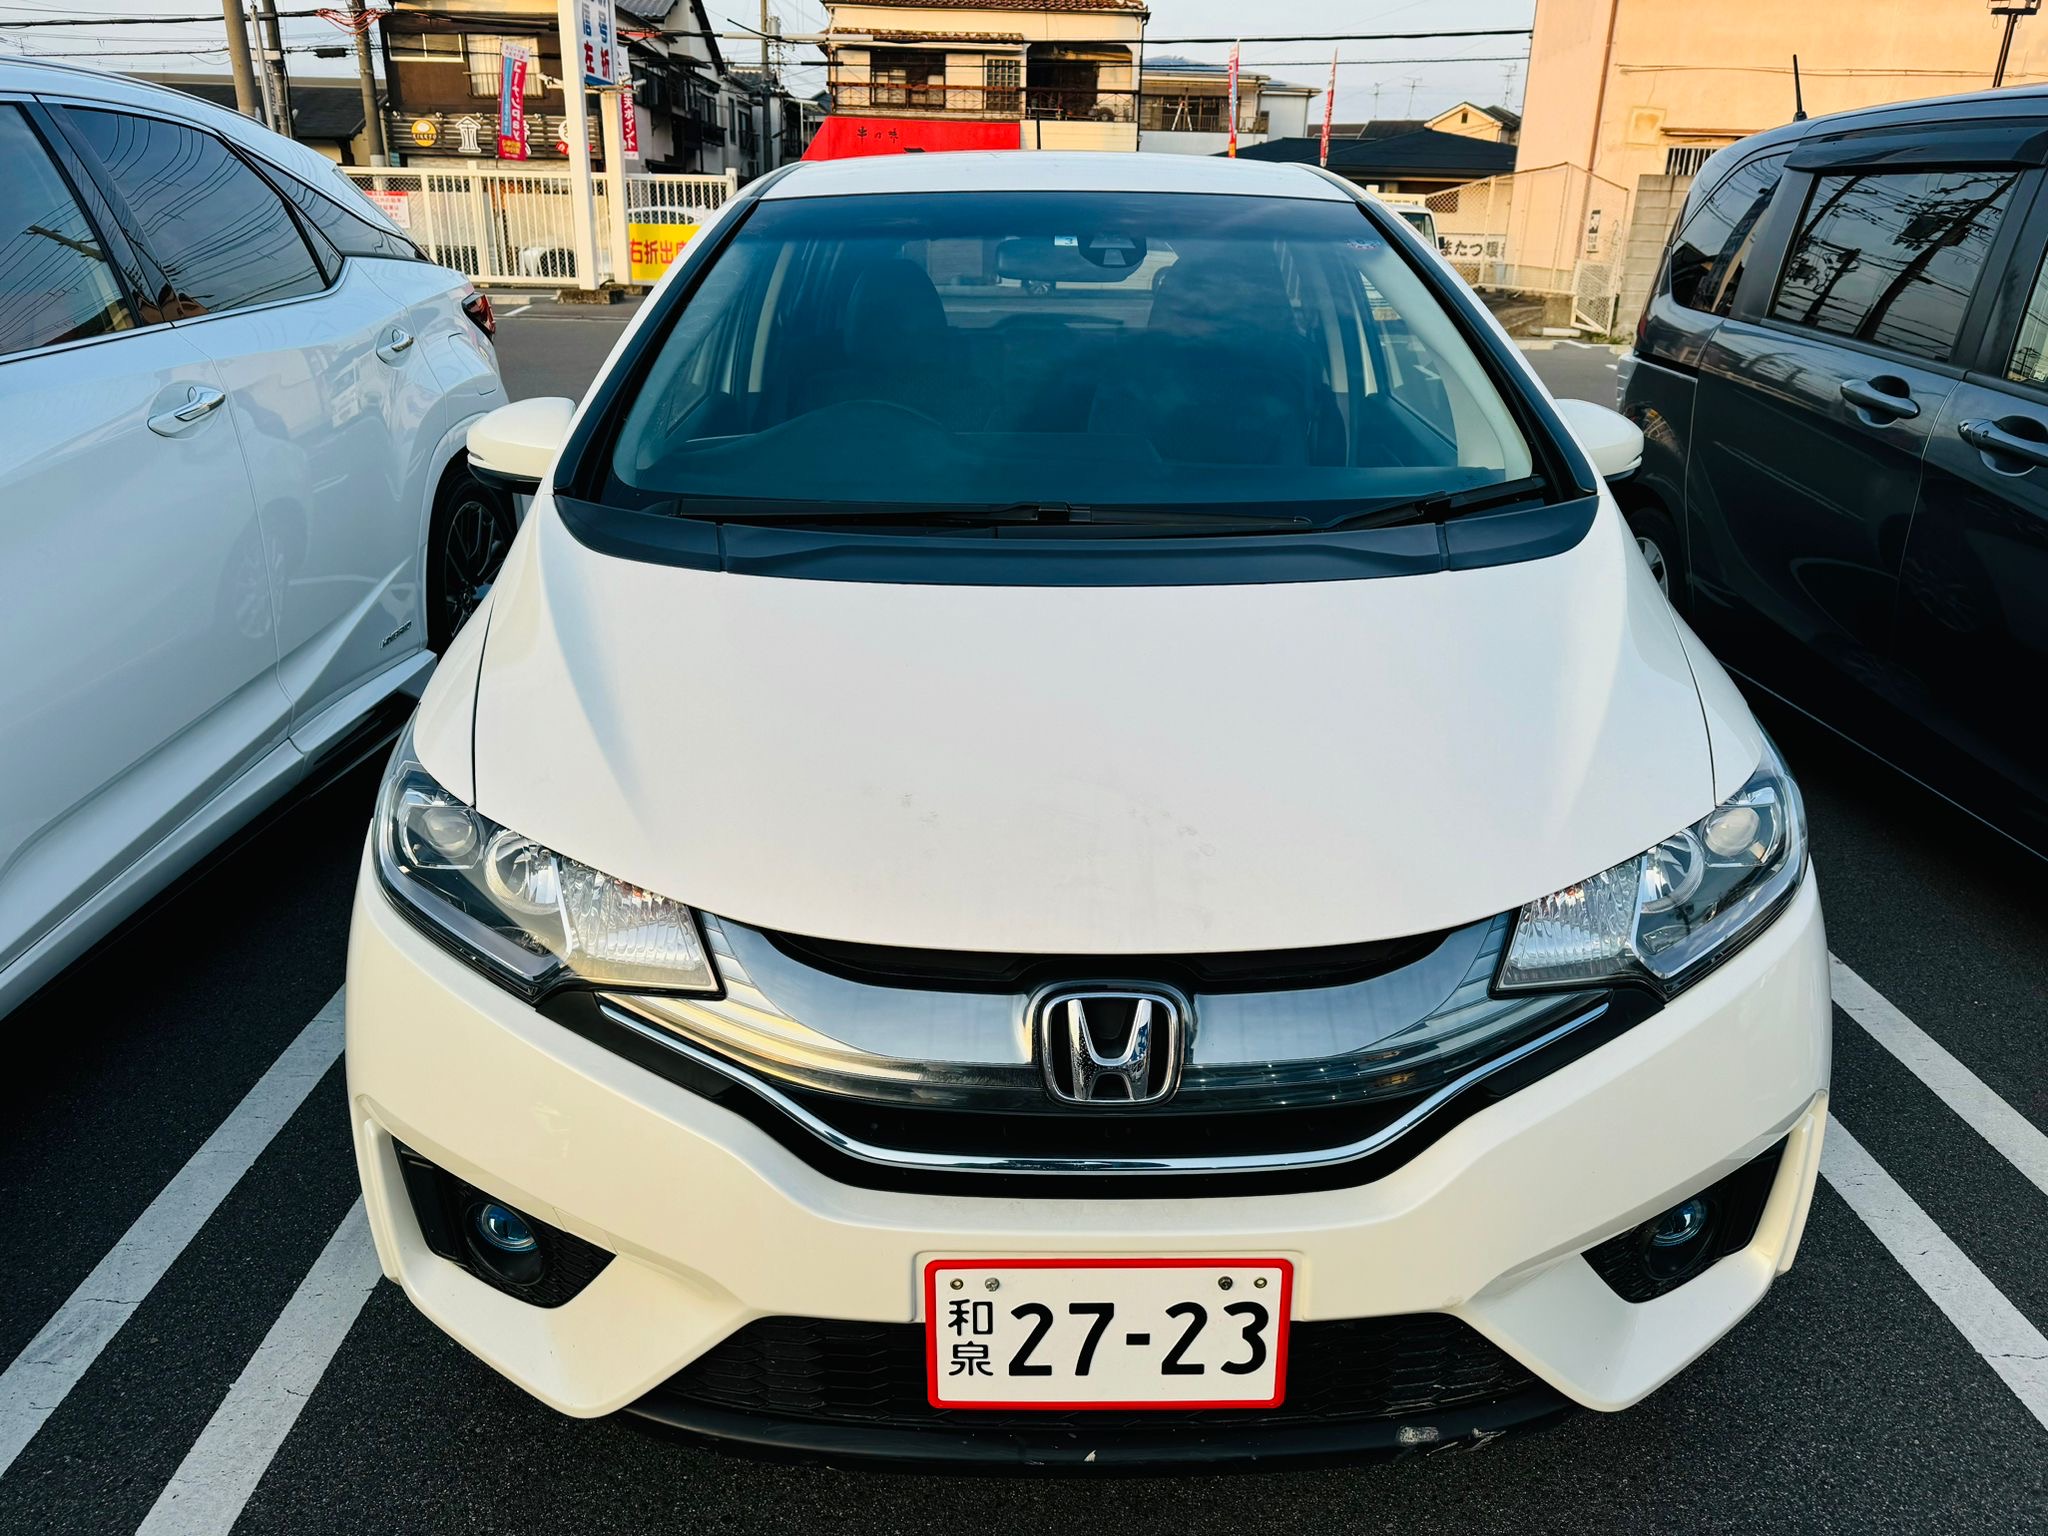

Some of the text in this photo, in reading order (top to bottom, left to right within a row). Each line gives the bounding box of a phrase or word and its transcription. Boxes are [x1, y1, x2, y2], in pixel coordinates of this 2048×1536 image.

[584, 40, 611, 80] 左折
[948, 1299, 994, 1377] 和泉
[1008, 1301, 1269, 1377] 27-23
